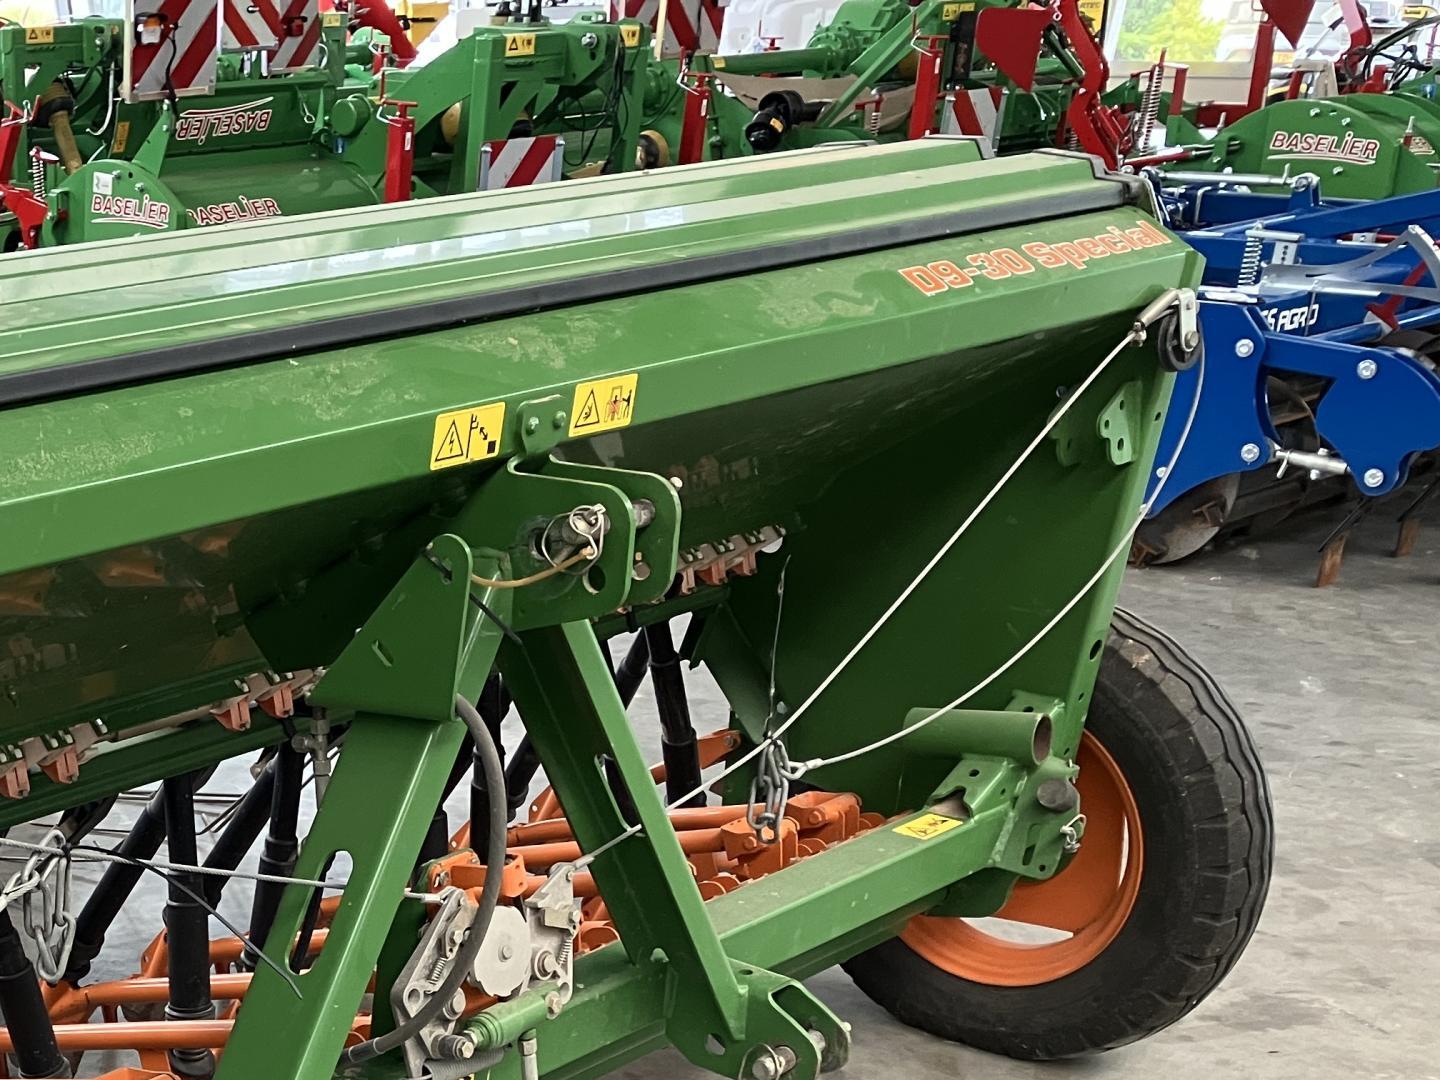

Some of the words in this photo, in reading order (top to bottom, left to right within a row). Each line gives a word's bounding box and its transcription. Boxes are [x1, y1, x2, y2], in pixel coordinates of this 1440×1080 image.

[1270, 131, 1380, 159] BASELIER
[92, 194, 170, 222] BASELIER
[899, 248, 1035, 296] D9-30
[1022, 220, 1172, 269] Special
[1277, 303, 1319, 332] AGRO
